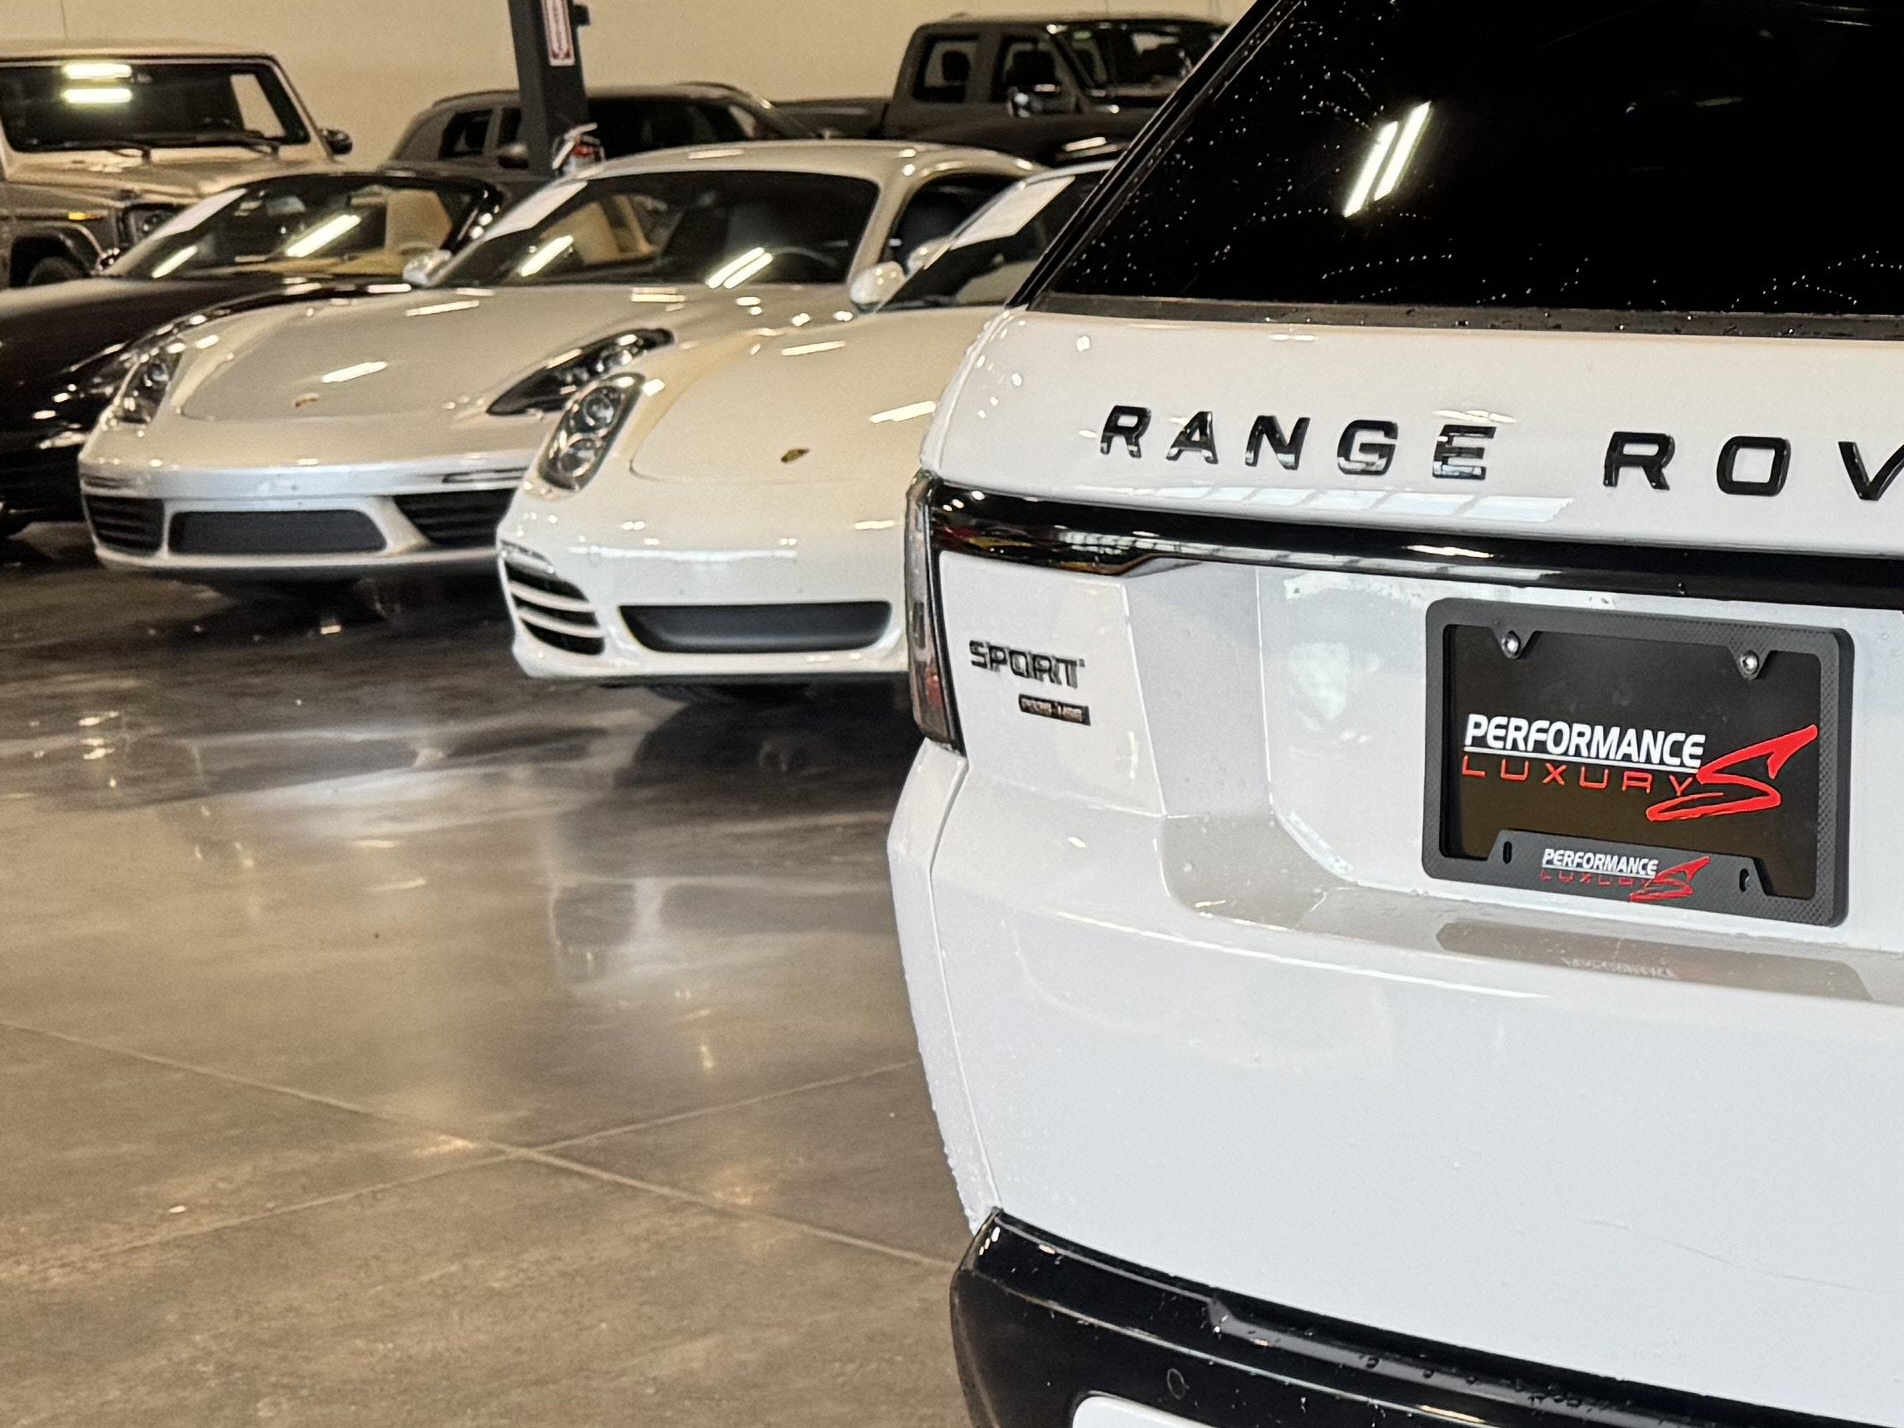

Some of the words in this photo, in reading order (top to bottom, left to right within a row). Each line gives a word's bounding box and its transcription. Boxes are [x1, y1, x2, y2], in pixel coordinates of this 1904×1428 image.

[1099, 404, 1497, 483] RANGE
[968, 639, 1078, 689] SPORT
[1465, 713, 1706, 768] PERFORMANCE
[1461, 754, 1693, 797] LUXURY
[1541, 848, 1659, 876] PERFORMANCE
